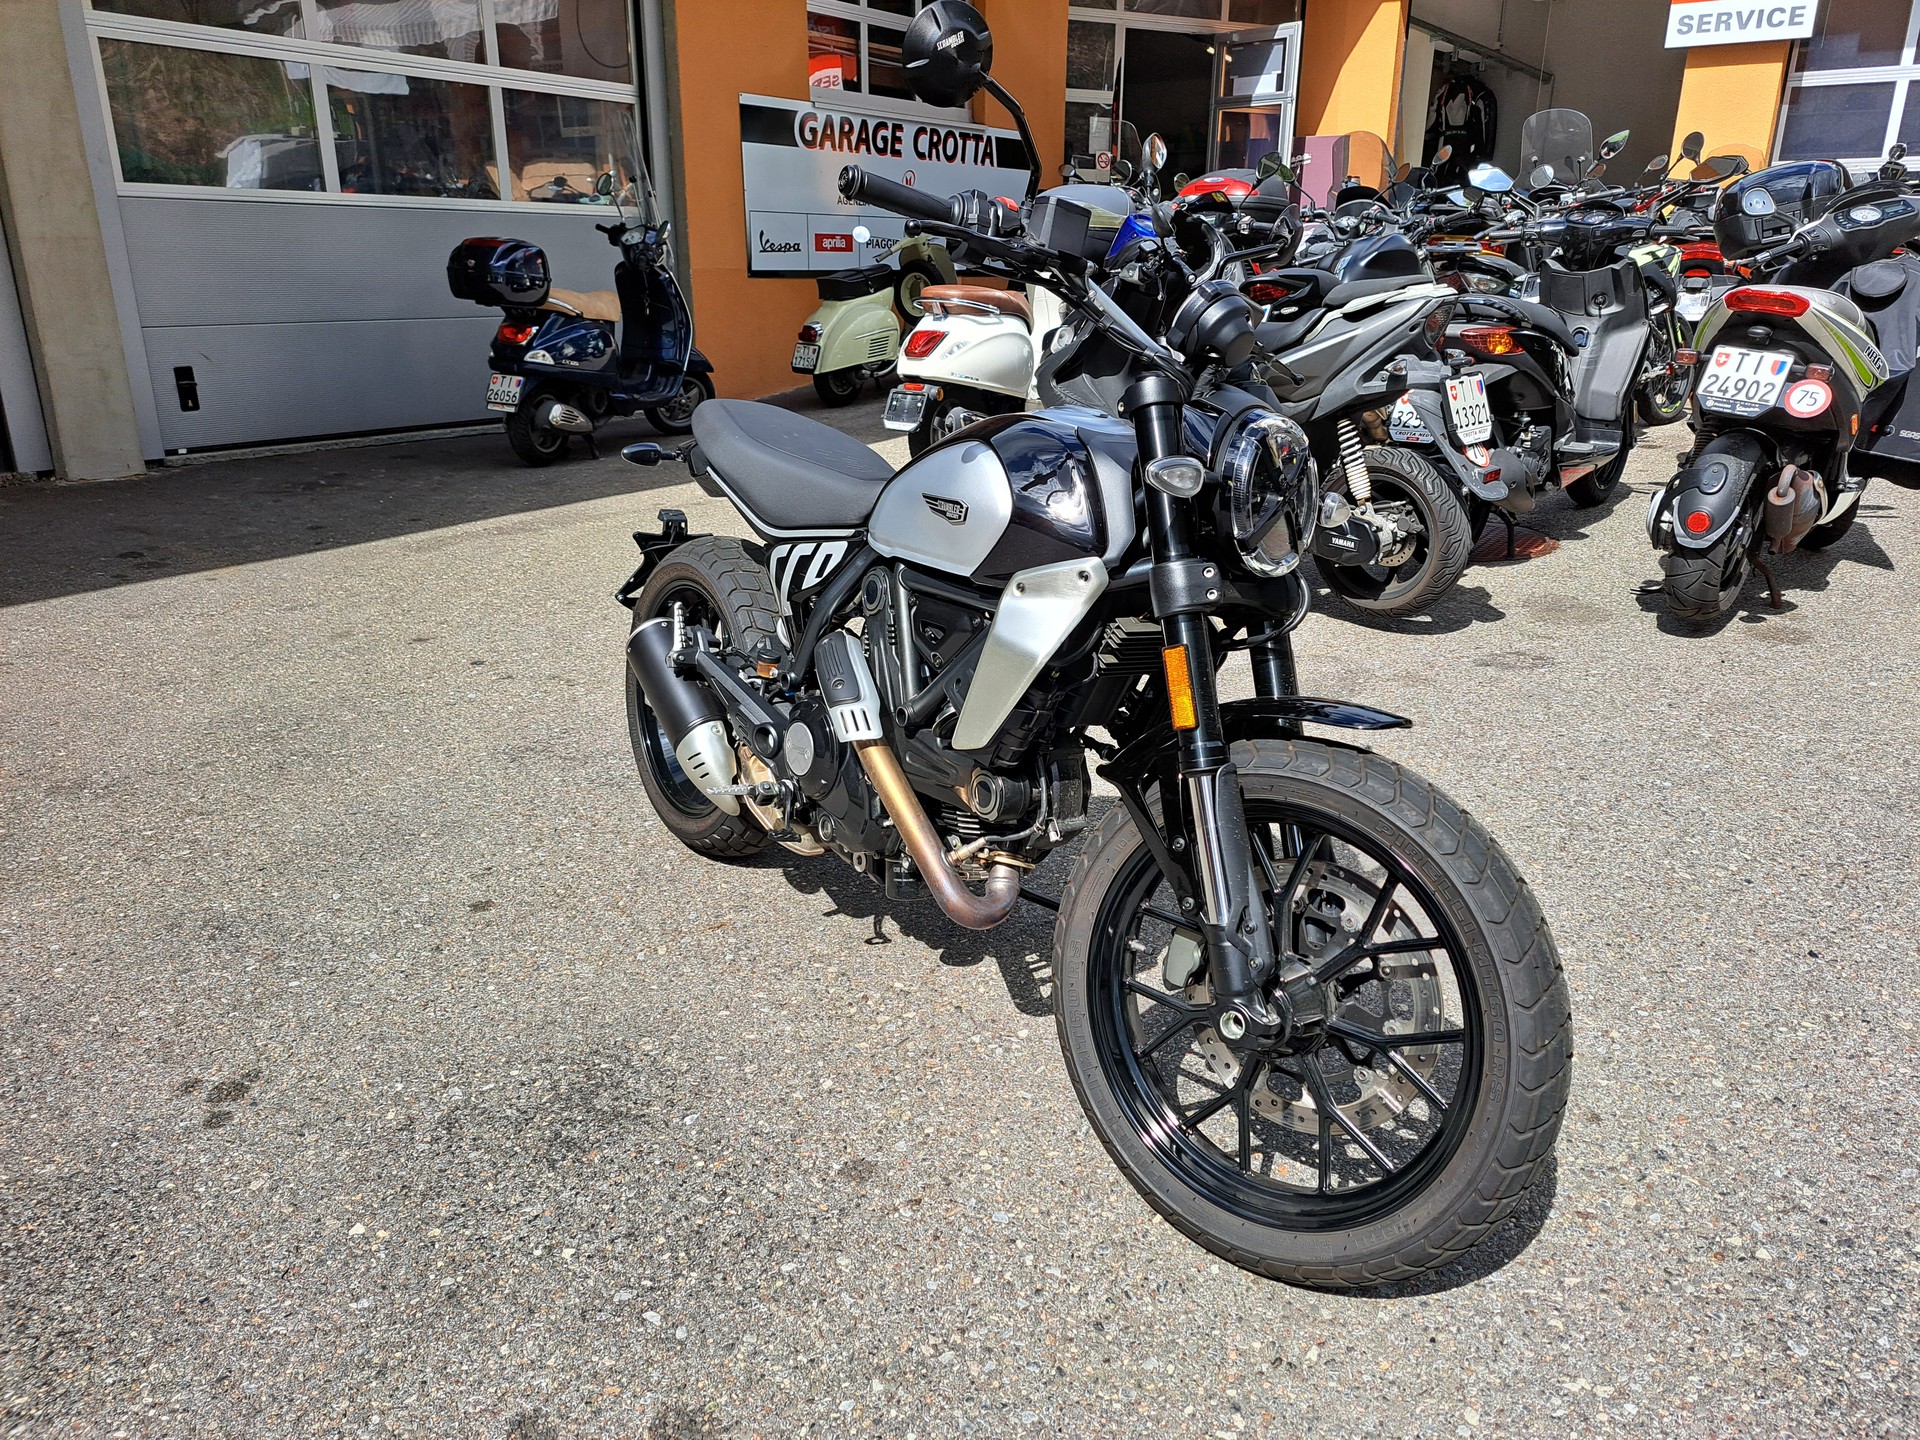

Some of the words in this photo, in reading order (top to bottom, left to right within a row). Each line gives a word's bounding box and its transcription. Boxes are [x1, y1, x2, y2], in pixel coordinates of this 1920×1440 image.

[1676, 5, 1807, 36] SERVICE
[799, 111, 904, 158] GARAGE
[912, 125, 995, 167] CROTTA
[759, 229, 802, 253] Vespa
[822, 235, 846, 250] aprilia
[1735, 351, 1765, 376] TI
[1864, 345, 1883, 371] NRG
[500, 375, 513, 388] TI
[1458, 379, 1475, 403] TI
[1701, 373, 1777, 404] 24902
[487, 388, 519, 403] 26056
[1796, 389, 1820, 407] 75
[1392, 410, 1428, 429] 325
[1455, 402, 1490, 429] 13321
[1331, 536, 1356, 549] YAMAHA
[1374, 817, 1477, 934] PIRELLI
